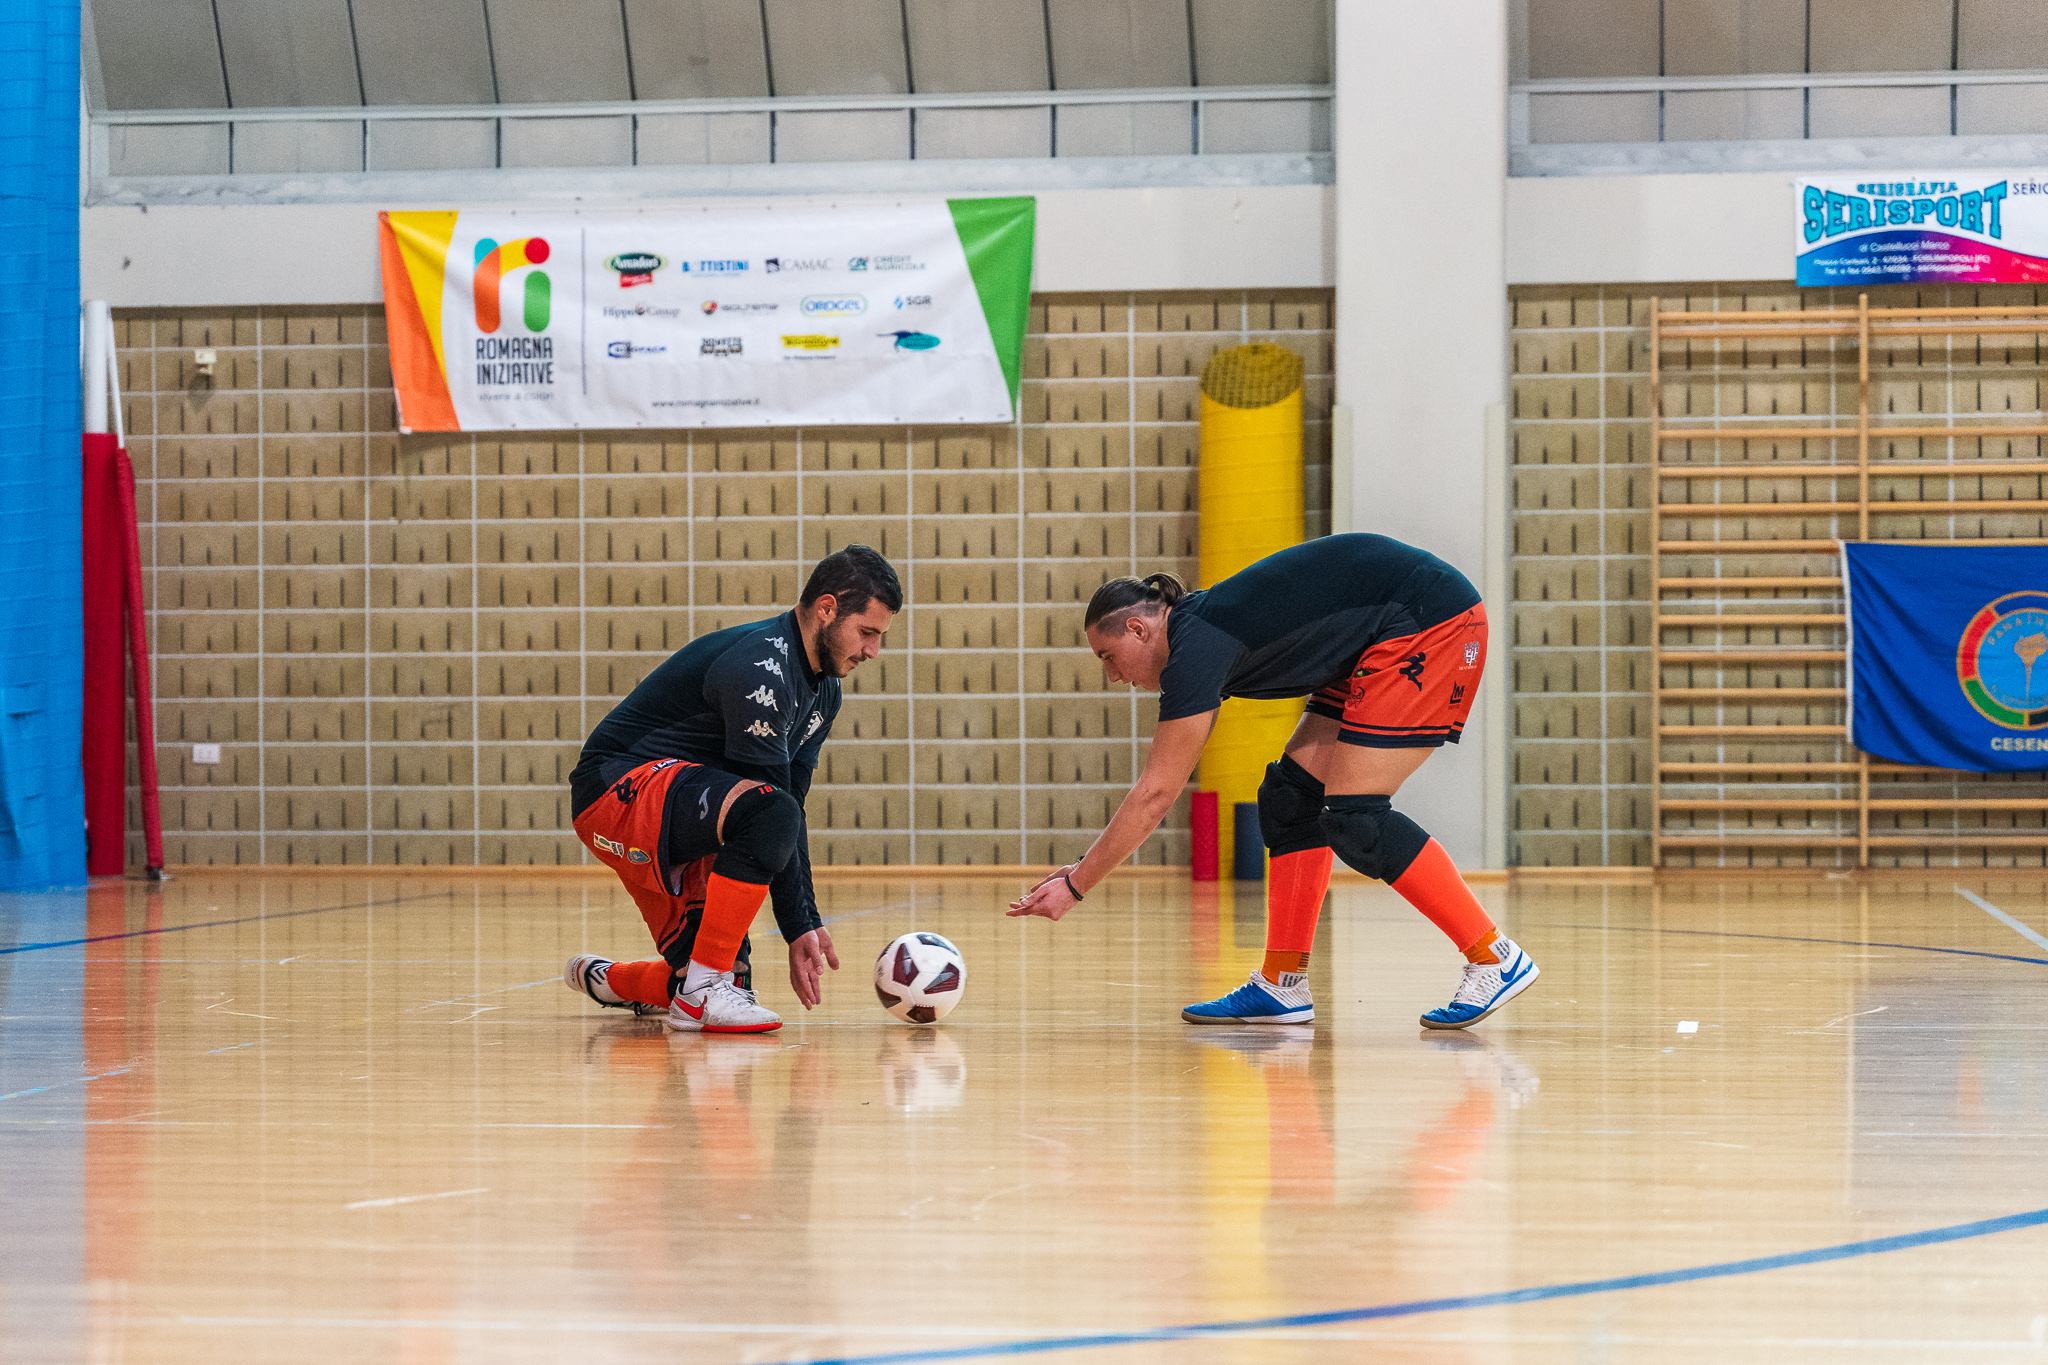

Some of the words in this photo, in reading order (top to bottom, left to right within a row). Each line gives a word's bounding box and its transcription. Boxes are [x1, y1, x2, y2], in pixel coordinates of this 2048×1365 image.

[1856, 182, 1958, 196] SERIGRAFIA
[1803, 180, 2008, 244] SERISPORT
[681, 260, 749, 273] BTTISTINI
[781, 257, 834, 271] CAMAC
[476, 337, 553, 360] ROMAGNA
[476, 361, 554, 385] INIZIATIVE
[1986, 614, 2048, 646] PANATH
